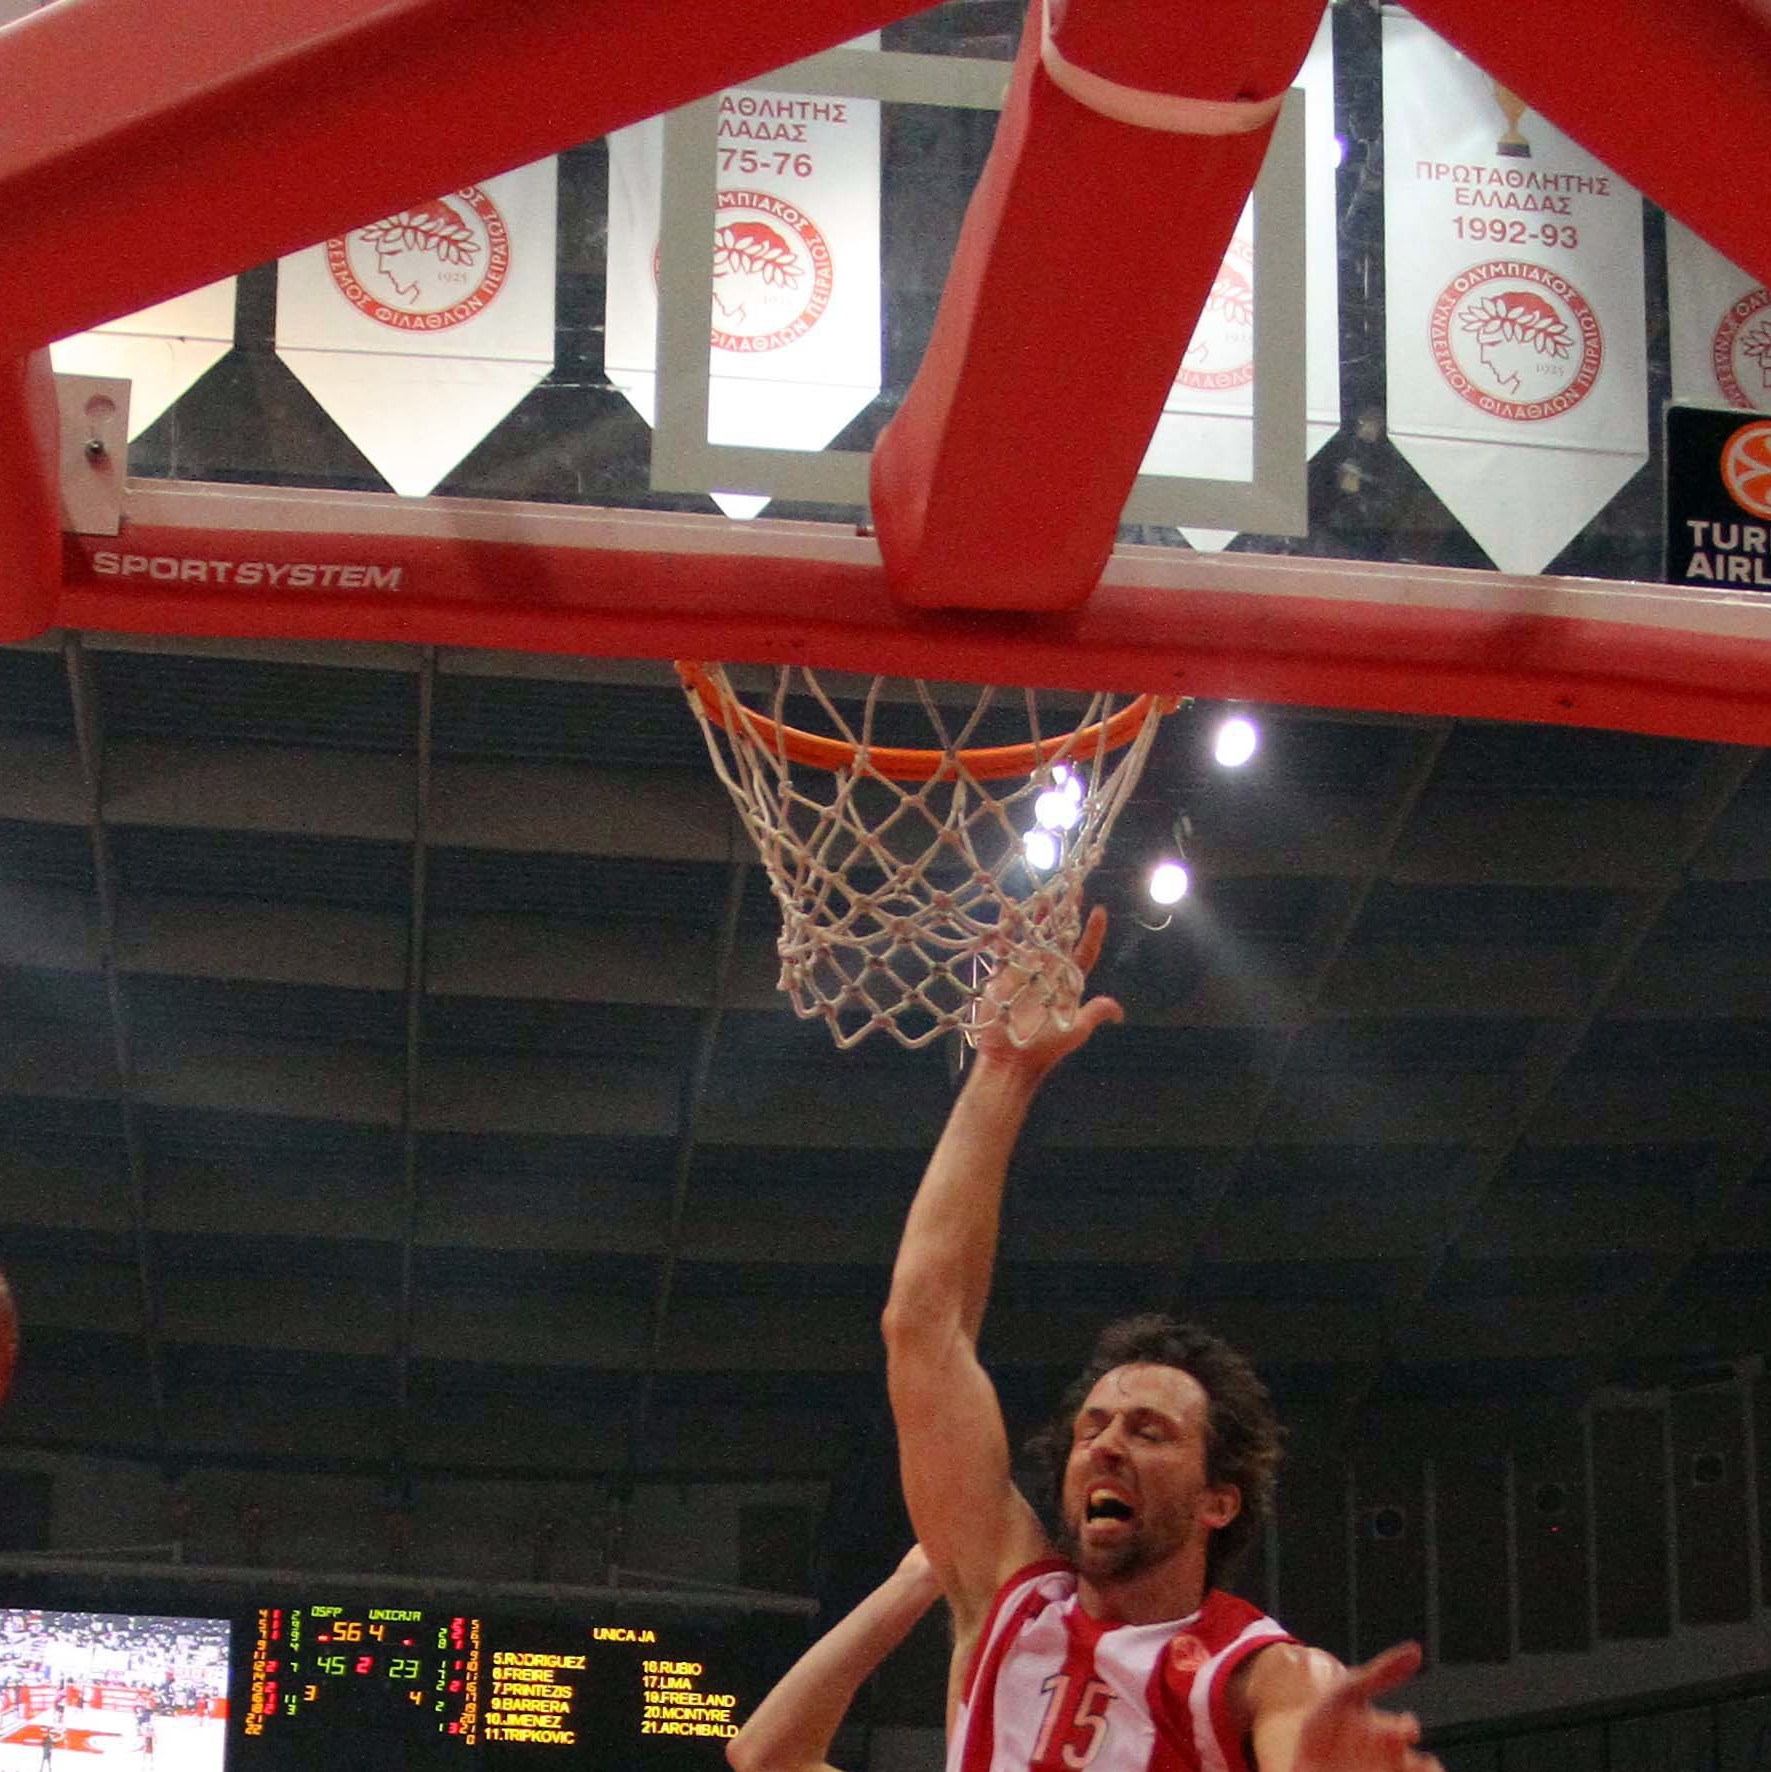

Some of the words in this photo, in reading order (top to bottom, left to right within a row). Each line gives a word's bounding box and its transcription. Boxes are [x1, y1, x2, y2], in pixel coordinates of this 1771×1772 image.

[718, 95, 848, 123] ΑΘΛΗΤΗΣ
[718, 119, 807, 143] ΛΑΔΑΣ
[718, 148, 813, 178] 75-76
[1416, 161, 1612, 197] ΠΡΩΤΑΘΛΗΤΗΣ
[718, 192, 809, 232] ΜΠΙΑΚΟΣ
[1455, 187, 1573, 216] ΕΛΛΑΔΑΣ
[1452, 216, 1579, 250] 1992-93
[328, 238, 374, 308] ΔΕΣΜΟΣ
[1454, 262, 1575, 301] ΟΛΥΜΠΙΑΚΟΣ
[375, 298, 485, 329] ΦΙΛΑΘΛΩΝ
[1479, 389, 1580, 419] ΦΙΛΑΘΛΩΝ
[333, 1621, 363, 1641] 56
[317, 1656, 346, 1675] 45
[355, 1656, 374, 1674] 2
[389, 1658, 420, 1678] 23
[408, 1691, 422, 1706] 4
[1031, 1671, 1119, 1769] 15
